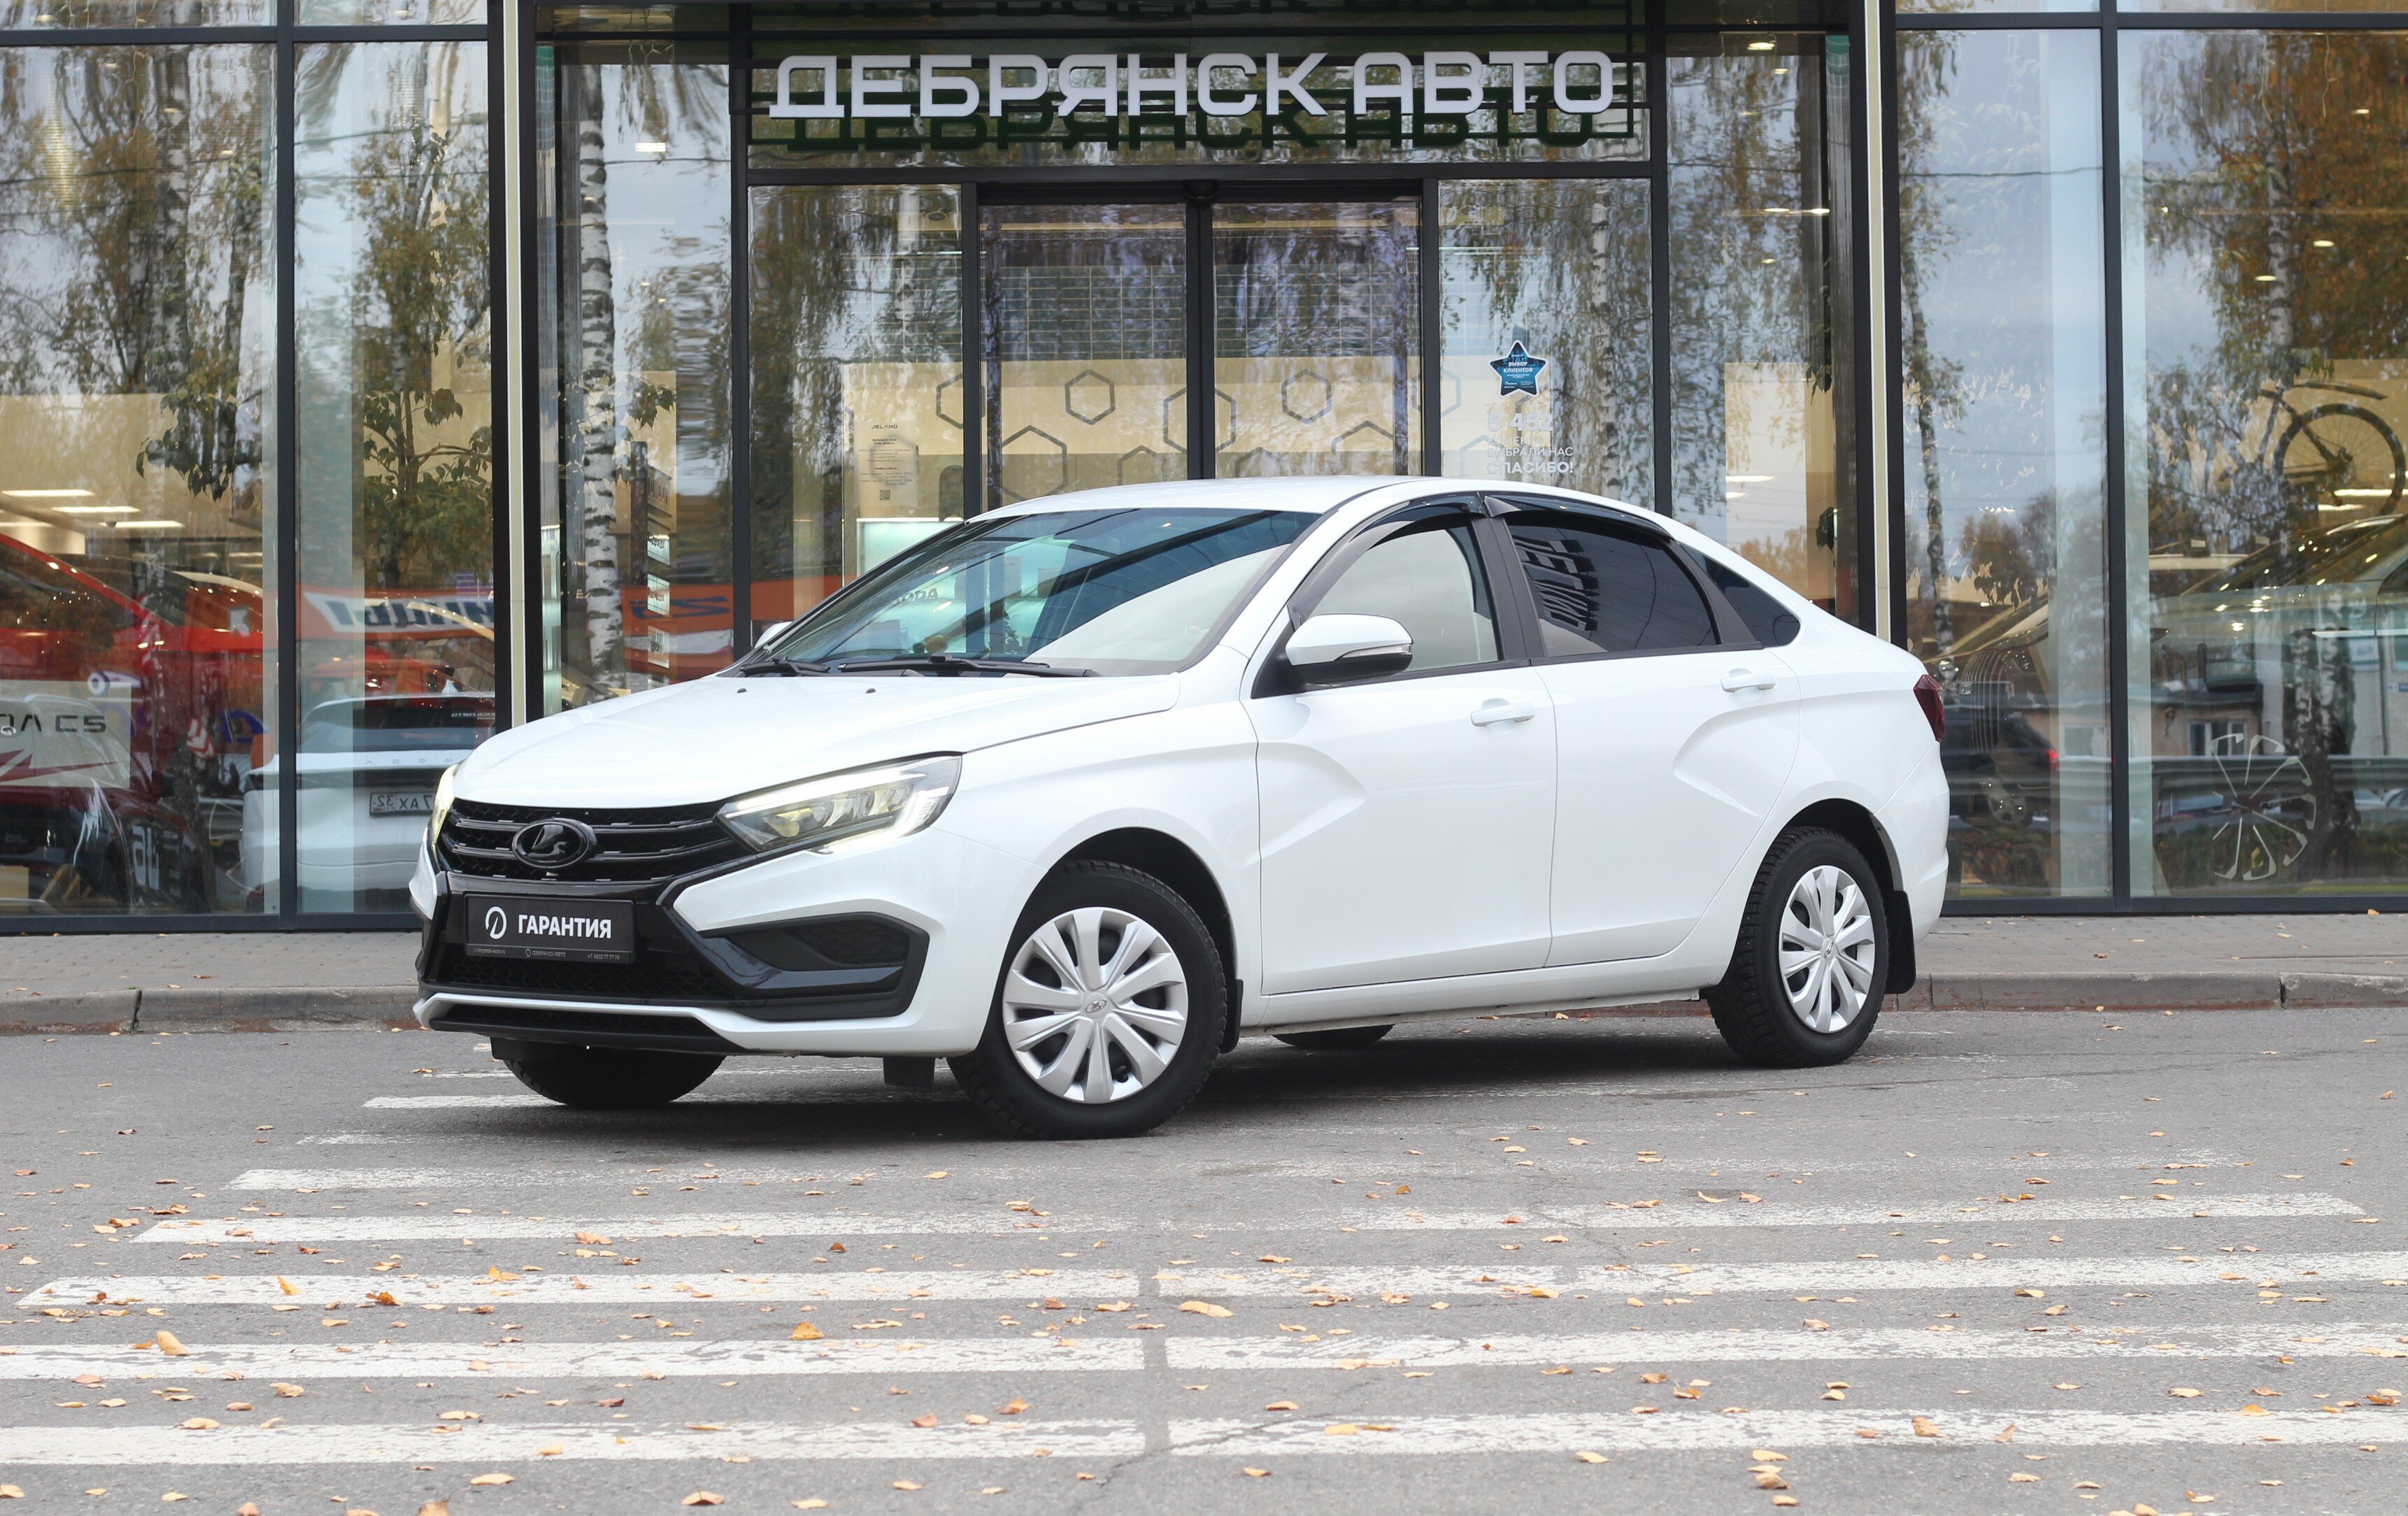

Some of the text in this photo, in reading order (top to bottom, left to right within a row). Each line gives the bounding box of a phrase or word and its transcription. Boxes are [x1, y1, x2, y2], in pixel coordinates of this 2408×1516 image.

[769, 50, 1613, 119] ДЕБРЯНСК АВТО
[1488, 413, 1553, 431] 5 452
[1549, 447, 1574, 457] НАС
[1487, 461, 1574, 475] СПАСИБО!
[518, 914, 611, 939] ГАРАНТИЯ
